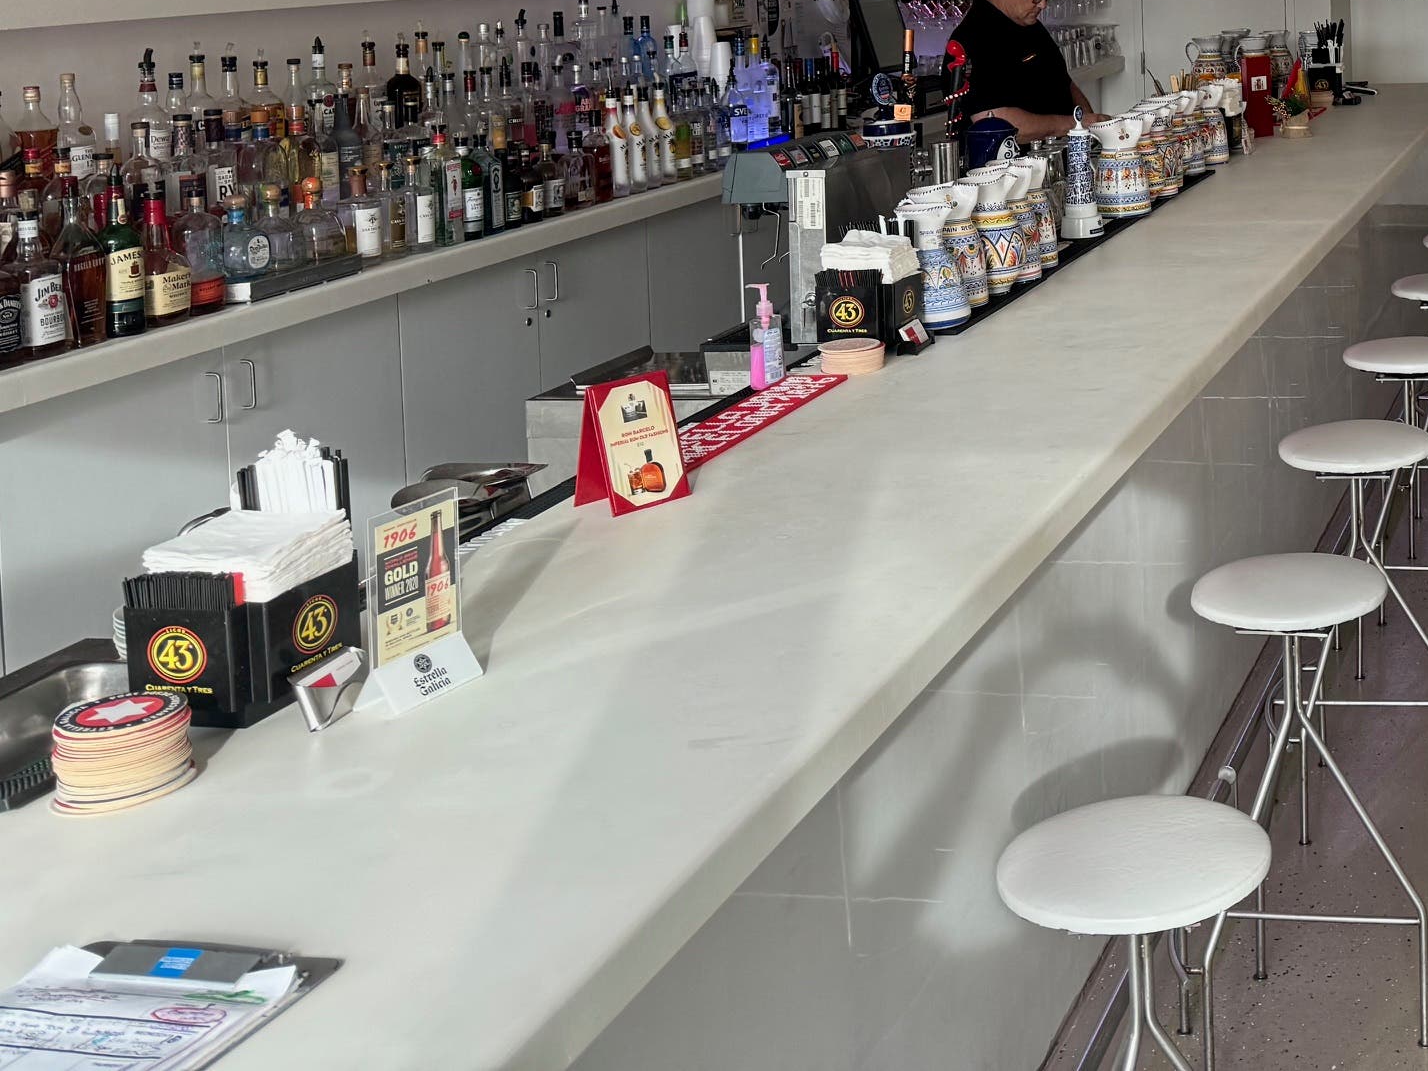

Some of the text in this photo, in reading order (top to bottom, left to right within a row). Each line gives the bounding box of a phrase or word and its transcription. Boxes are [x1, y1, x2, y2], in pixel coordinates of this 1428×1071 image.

[34, 284, 50, 302] JIM
[835, 303, 857, 320] 43
[383, 523, 418, 549] 1906
[384, 560, 419, 586] GOLD
[301, 606, 329, 641] 43
[158, 639, 192, 671] 43
[413, 667, 448, 688] Estrella
[420, 677, 452, 696] Galicia
[192, 686, 214, 695] TRES
